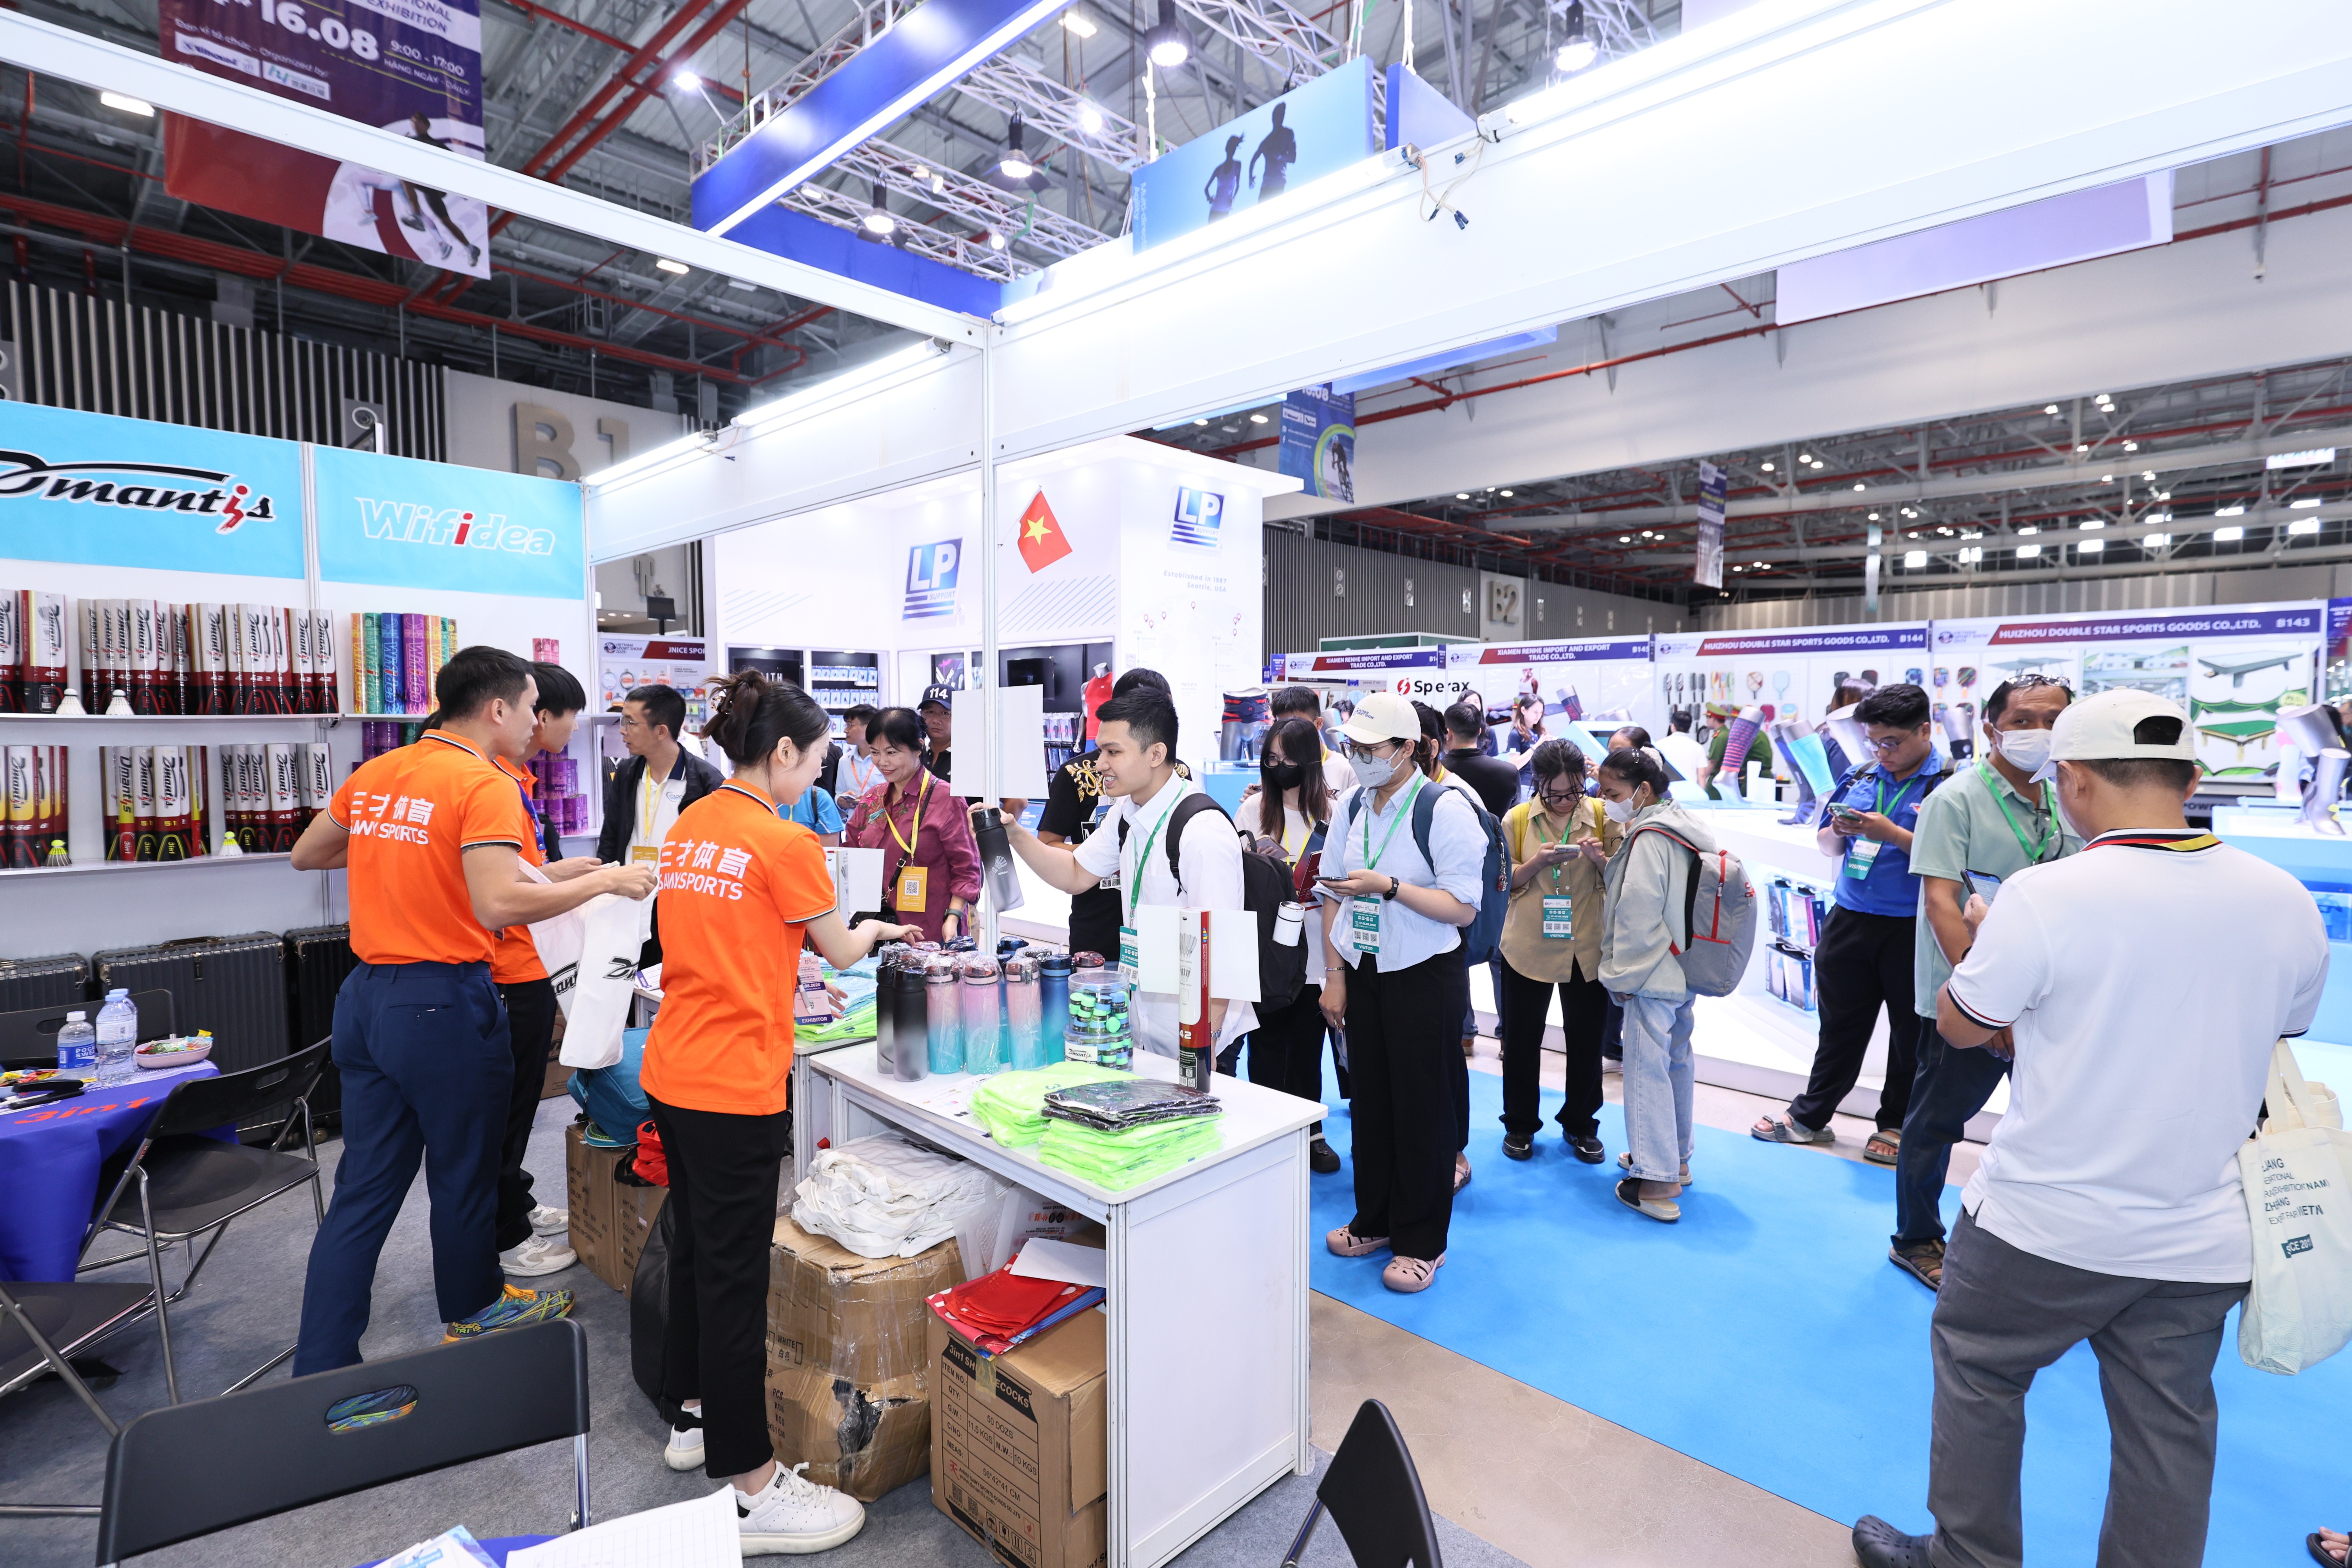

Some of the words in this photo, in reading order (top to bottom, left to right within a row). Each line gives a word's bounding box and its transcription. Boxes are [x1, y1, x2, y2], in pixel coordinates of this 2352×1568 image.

[261, 0, 379, 64] 16.08
[391, 40, 422, 60] 9:00
[432, 54, 465, 77] 17:00
[446, 80, 470, 95] DAILY
[1178, 488, 1221, 525] LP
[354, 497, 555, 555] Wifidea
[1196, 527, 1219, 536] SUPPORT
[909, 543, 956, 591] LP
[1163, 570, 1203, 581] Established
[929, 591, 956, 600] SUPPORT
[1187, 582, 1212, 591] Seattle,
[1488, 580, 1519, 625] B2
[1999, 629, 2047, 639] HUIZHOU
[2049, 627, 2091, 637] DOUBLE
[2093, 626, 2122, 635] STAR
[2122, 622, 2165, 633] SPORTS
[2167, 621, 2210, 632] GOODS
[2276, 618, 2310, 628] B143
[1704, 642, 1738, 650] HUIZHOU
[1739, 640, 1769, 649] DOUBLE
[1771, 639, 1791, 648] STAR
[1792, 637, 1823, 646] SPORTS
[1824, 636, 1854, 645] GOODS
[1899, 634, 1924, 642] B144
[930, 687, 948, 699] 114
[377, 823, 429, 845] SPORTS
[659, 839, 752, 879] 三才体育
[1849, 863, 1869, 871] VISITOR
[942, 1362, 955, 1377] ITEM
[956, 1373, 967, 1387] NO.:
[949, 1345, 964, 1362] 3in1
[965, 1357, 1029, 1408] SHECOCKS
[949, 1385, 961, 1400] QTY:
[947, 1404, 962, 1420] G.W.:
[947, 1422, 962, 1439] C/NO:
[968, 1421, 978, 1434] 11.5
[980, 1429, 993, 1444] KGS
[987, 1415, 994, 1425] 50
[995, 1421, 1013, 1439] DOZS
[947, 1440, 964, 1458] MEAS:
[996, 1441, 1012, 1458] N.W.:
[1014, 1454, 1021, 1465] 10
[1023, 1461, 1037, 1475] KGS
[959, 1474, 995, 1506] www.dmantis.com
[980, 1483, 993, 1497] SPORTS
[994, 1494, 1006, 1508] GOODS
[1010, 1489, 1020, 1502] CM
